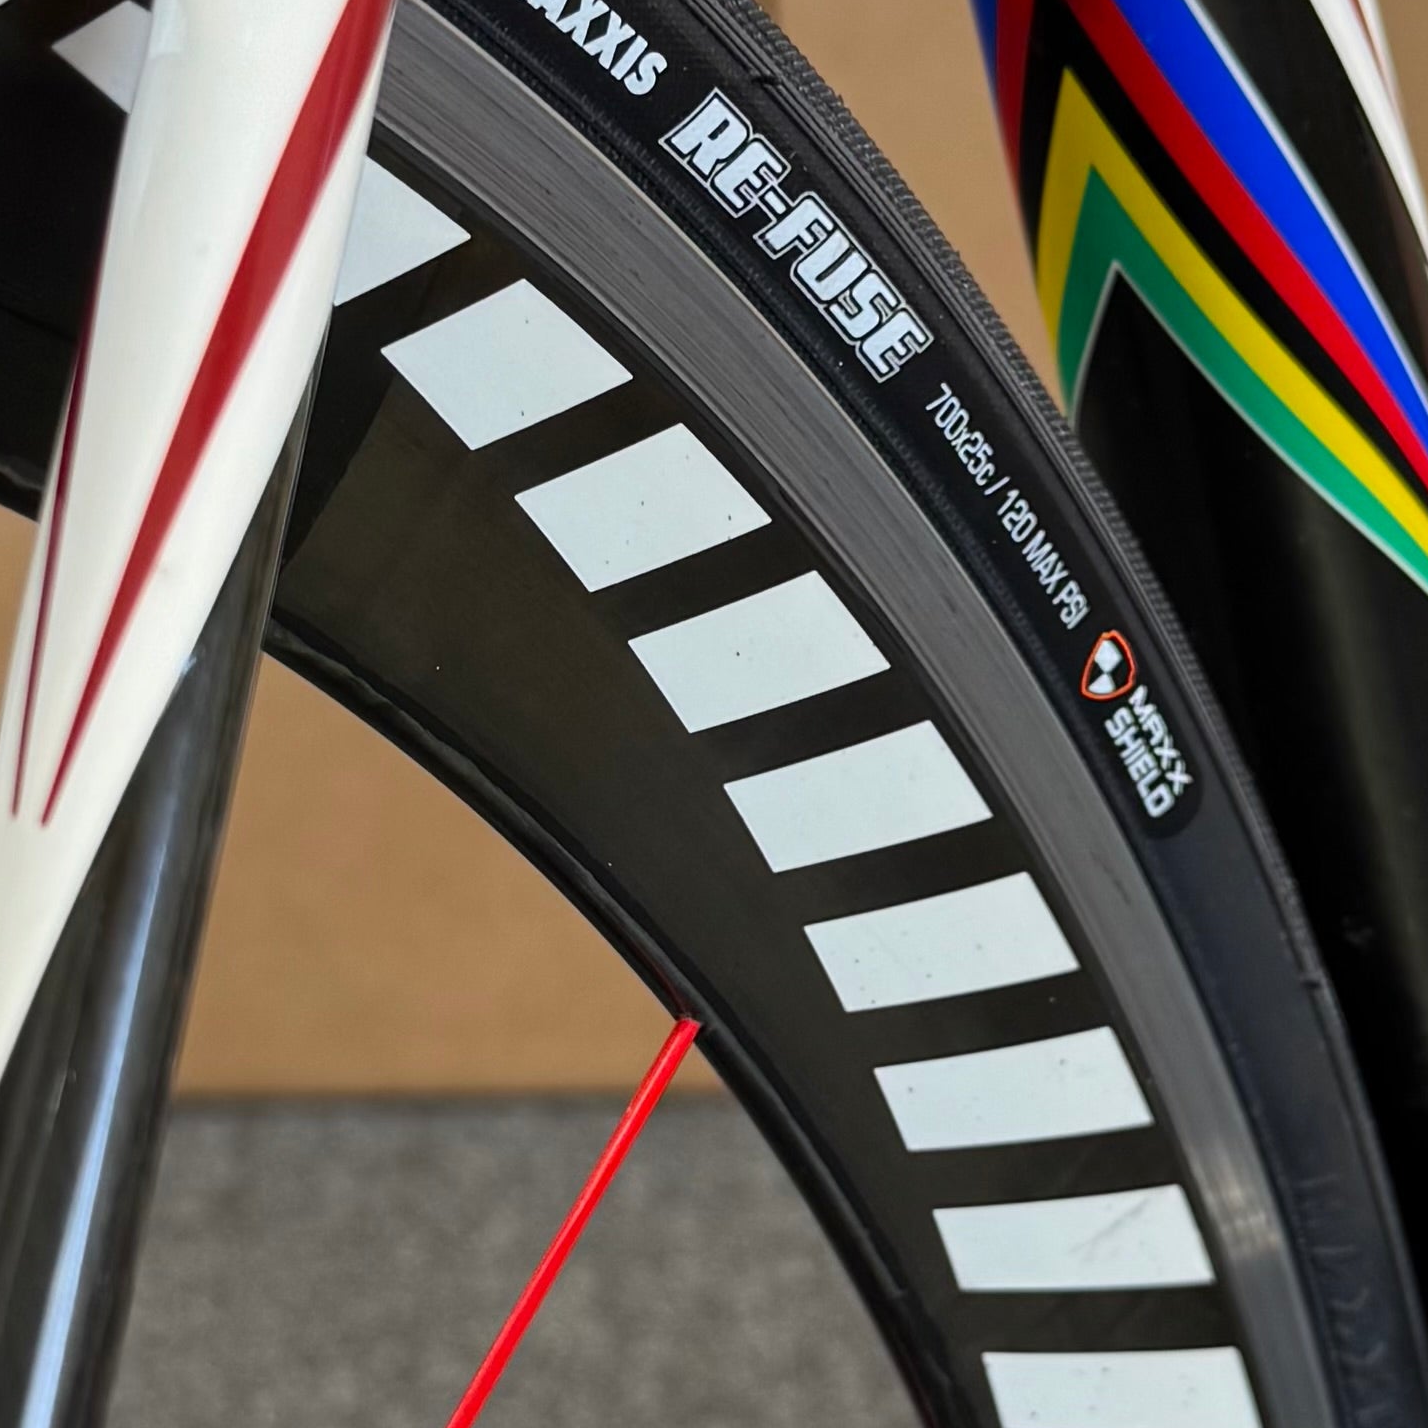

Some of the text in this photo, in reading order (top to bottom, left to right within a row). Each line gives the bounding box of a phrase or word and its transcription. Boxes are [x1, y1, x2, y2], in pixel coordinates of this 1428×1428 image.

[657, 86, 934, 383] RE-FUSE
[925, 382, 996, 487] 700x25c
[997, 488, 1038, 544] 120
[1021, 530, 1068, 594] MAX
[1052, 578, 1092, 630] PSI
[1103, 706, 1176, 819] SHIELD
[1128, 684, 1194, 797] MAXX
